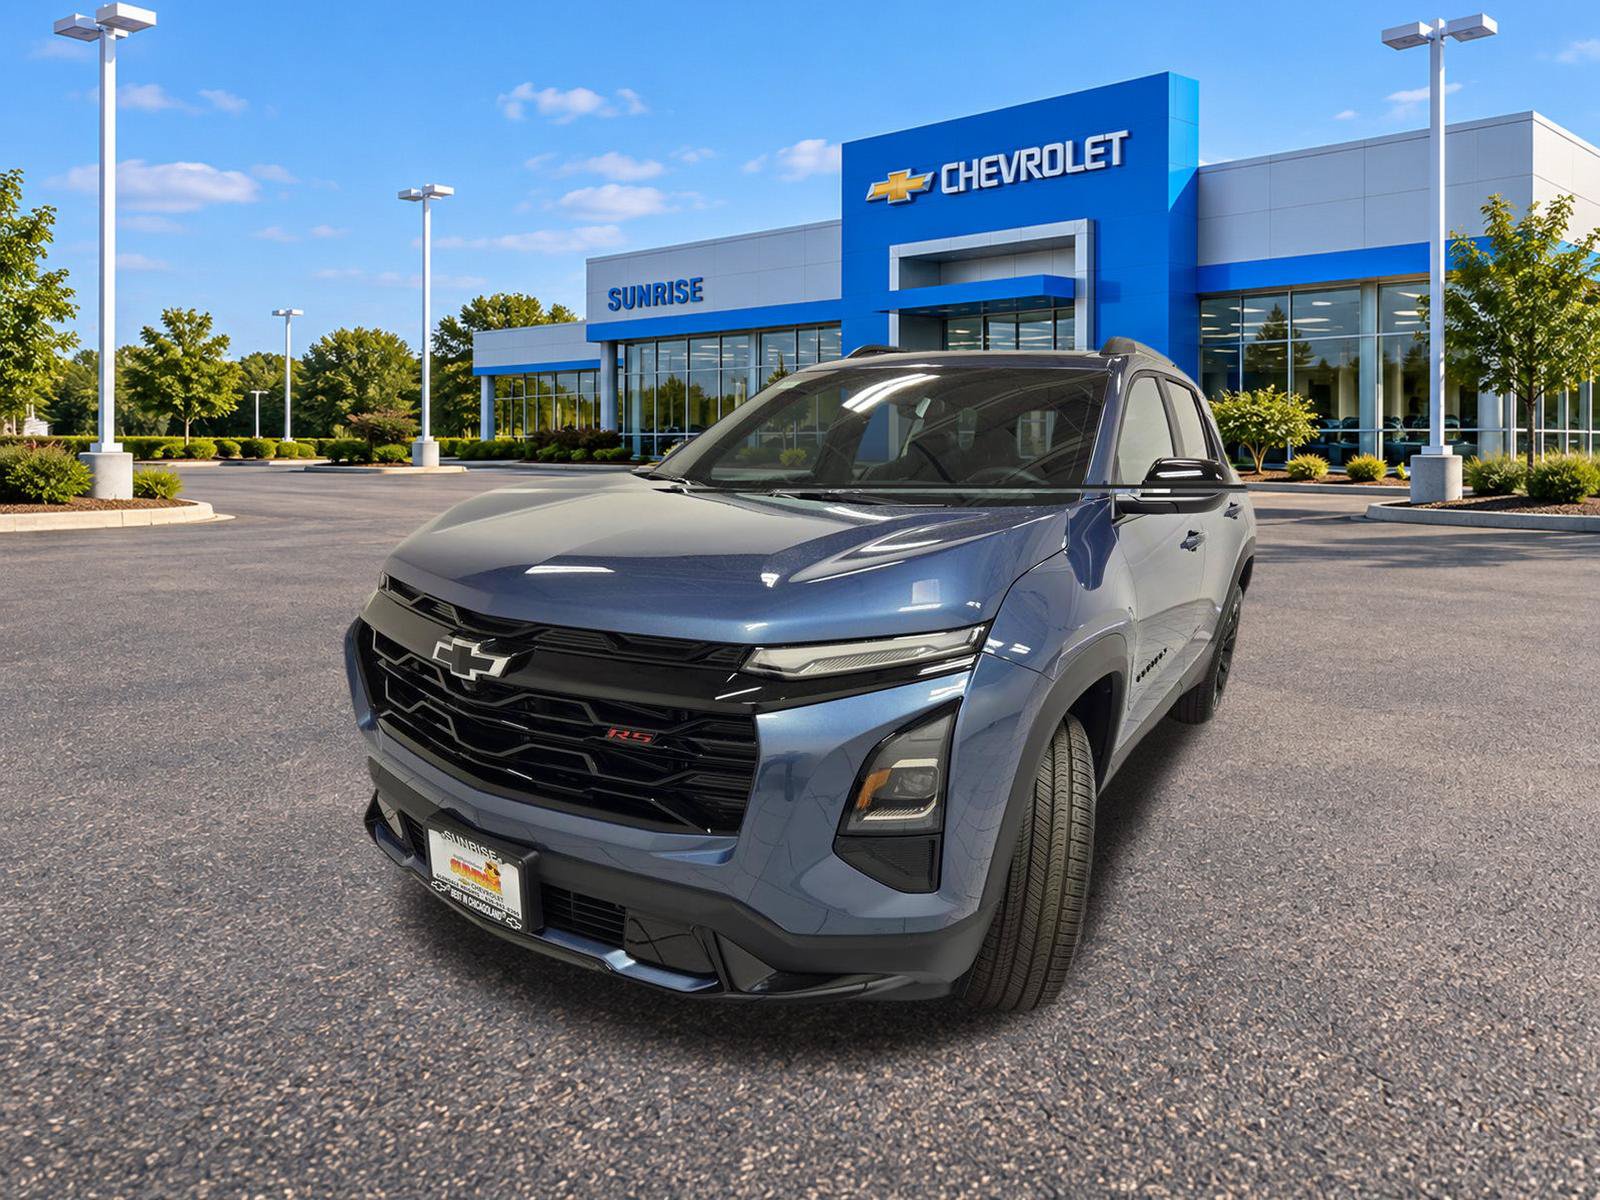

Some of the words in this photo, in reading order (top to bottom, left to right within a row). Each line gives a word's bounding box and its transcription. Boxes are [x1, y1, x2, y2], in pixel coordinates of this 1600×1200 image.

[940, 130, 1129, 195] CHEVROLET
[607, 277, 704, 311] SUNRISE
[606, 726, 655, 744] RS
[444, 830, 498, 861] SUNRISE
[450, 888, 462, 900] BEST
